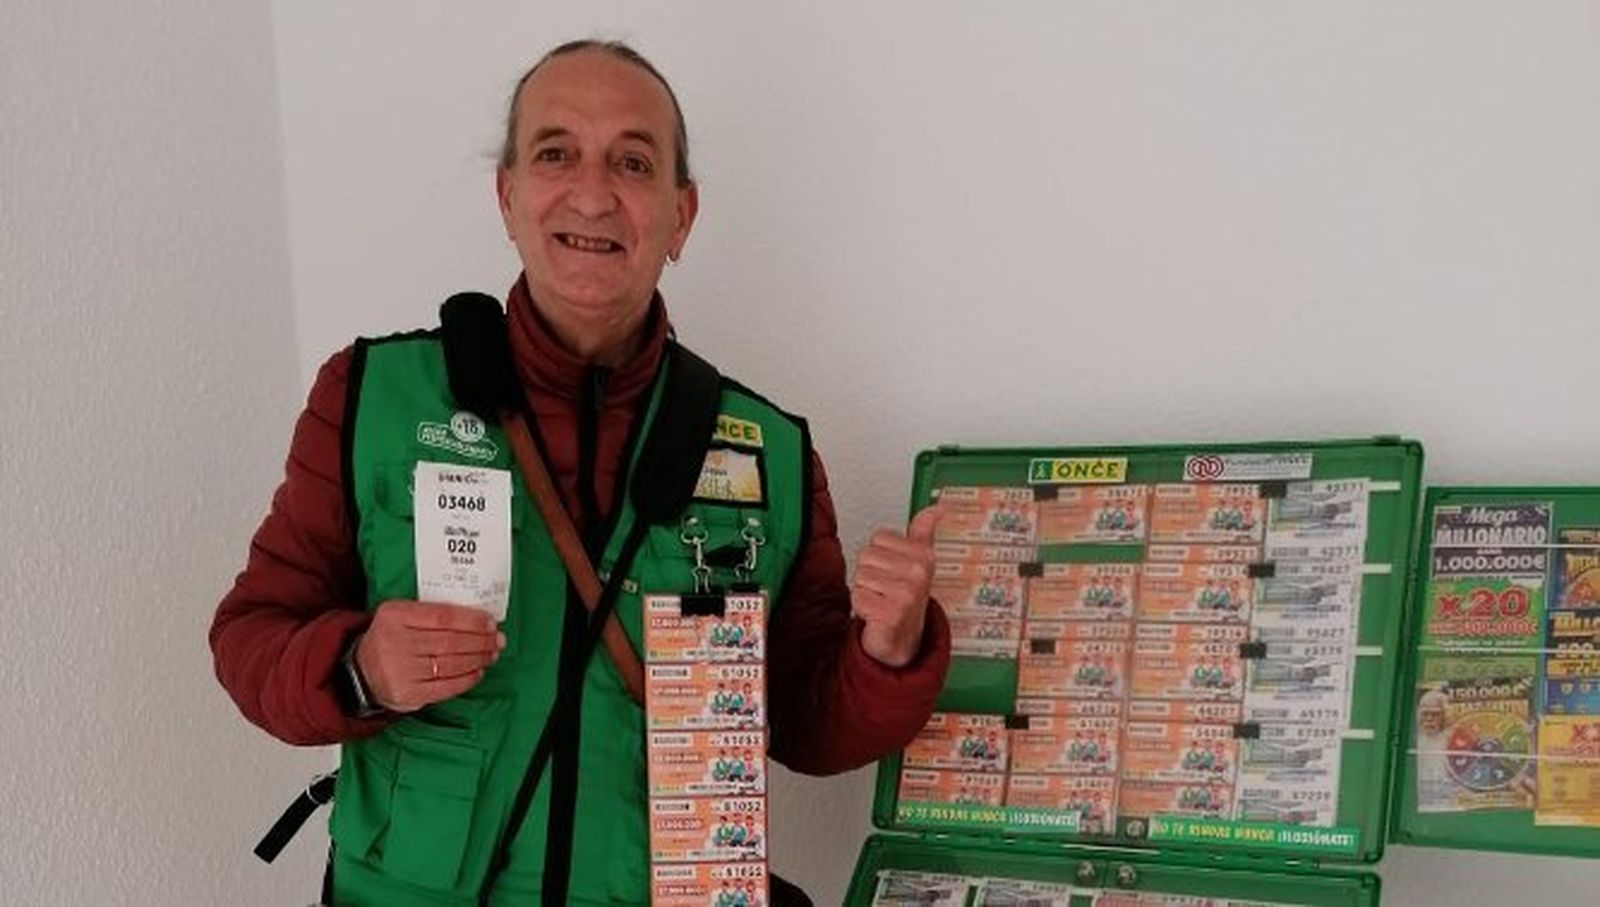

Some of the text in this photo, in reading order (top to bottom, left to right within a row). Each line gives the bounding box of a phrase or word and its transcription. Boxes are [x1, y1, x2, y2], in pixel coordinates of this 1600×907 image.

[1057, 461, 1119, 478] ONCE
[438, 494, 485, 512] 03468
[1465, 506, 1519, 527] Mega
[1436, 527, 1546, 544] MILLONARIO
[448, 539, 477, 554] 020
[1436, 554, 1545, 571] 1.000.000€
